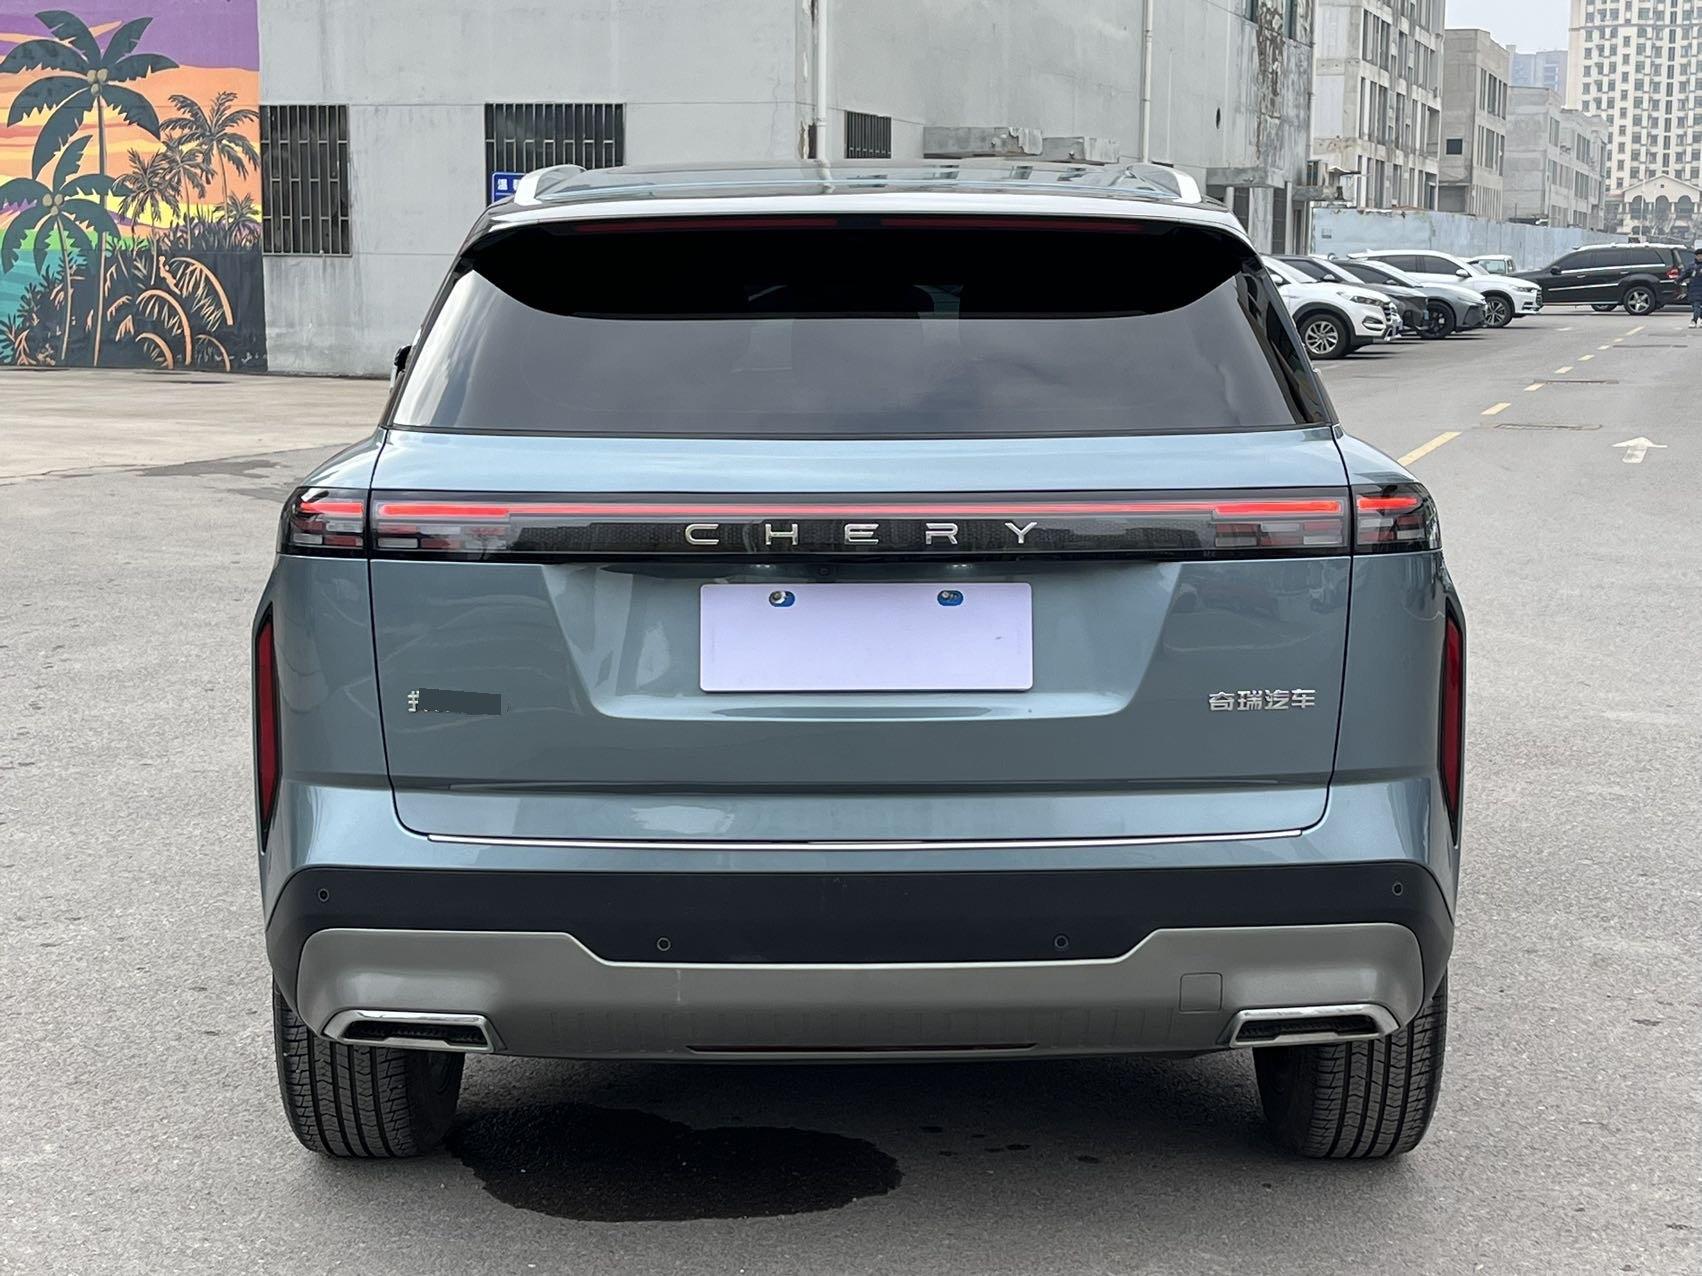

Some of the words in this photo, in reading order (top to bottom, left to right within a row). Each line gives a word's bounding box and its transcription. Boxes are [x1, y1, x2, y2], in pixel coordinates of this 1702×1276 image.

[684, 522, 1038, 546] CHERY
[1208, 688, 1316, 711] 奇瑞汽车
